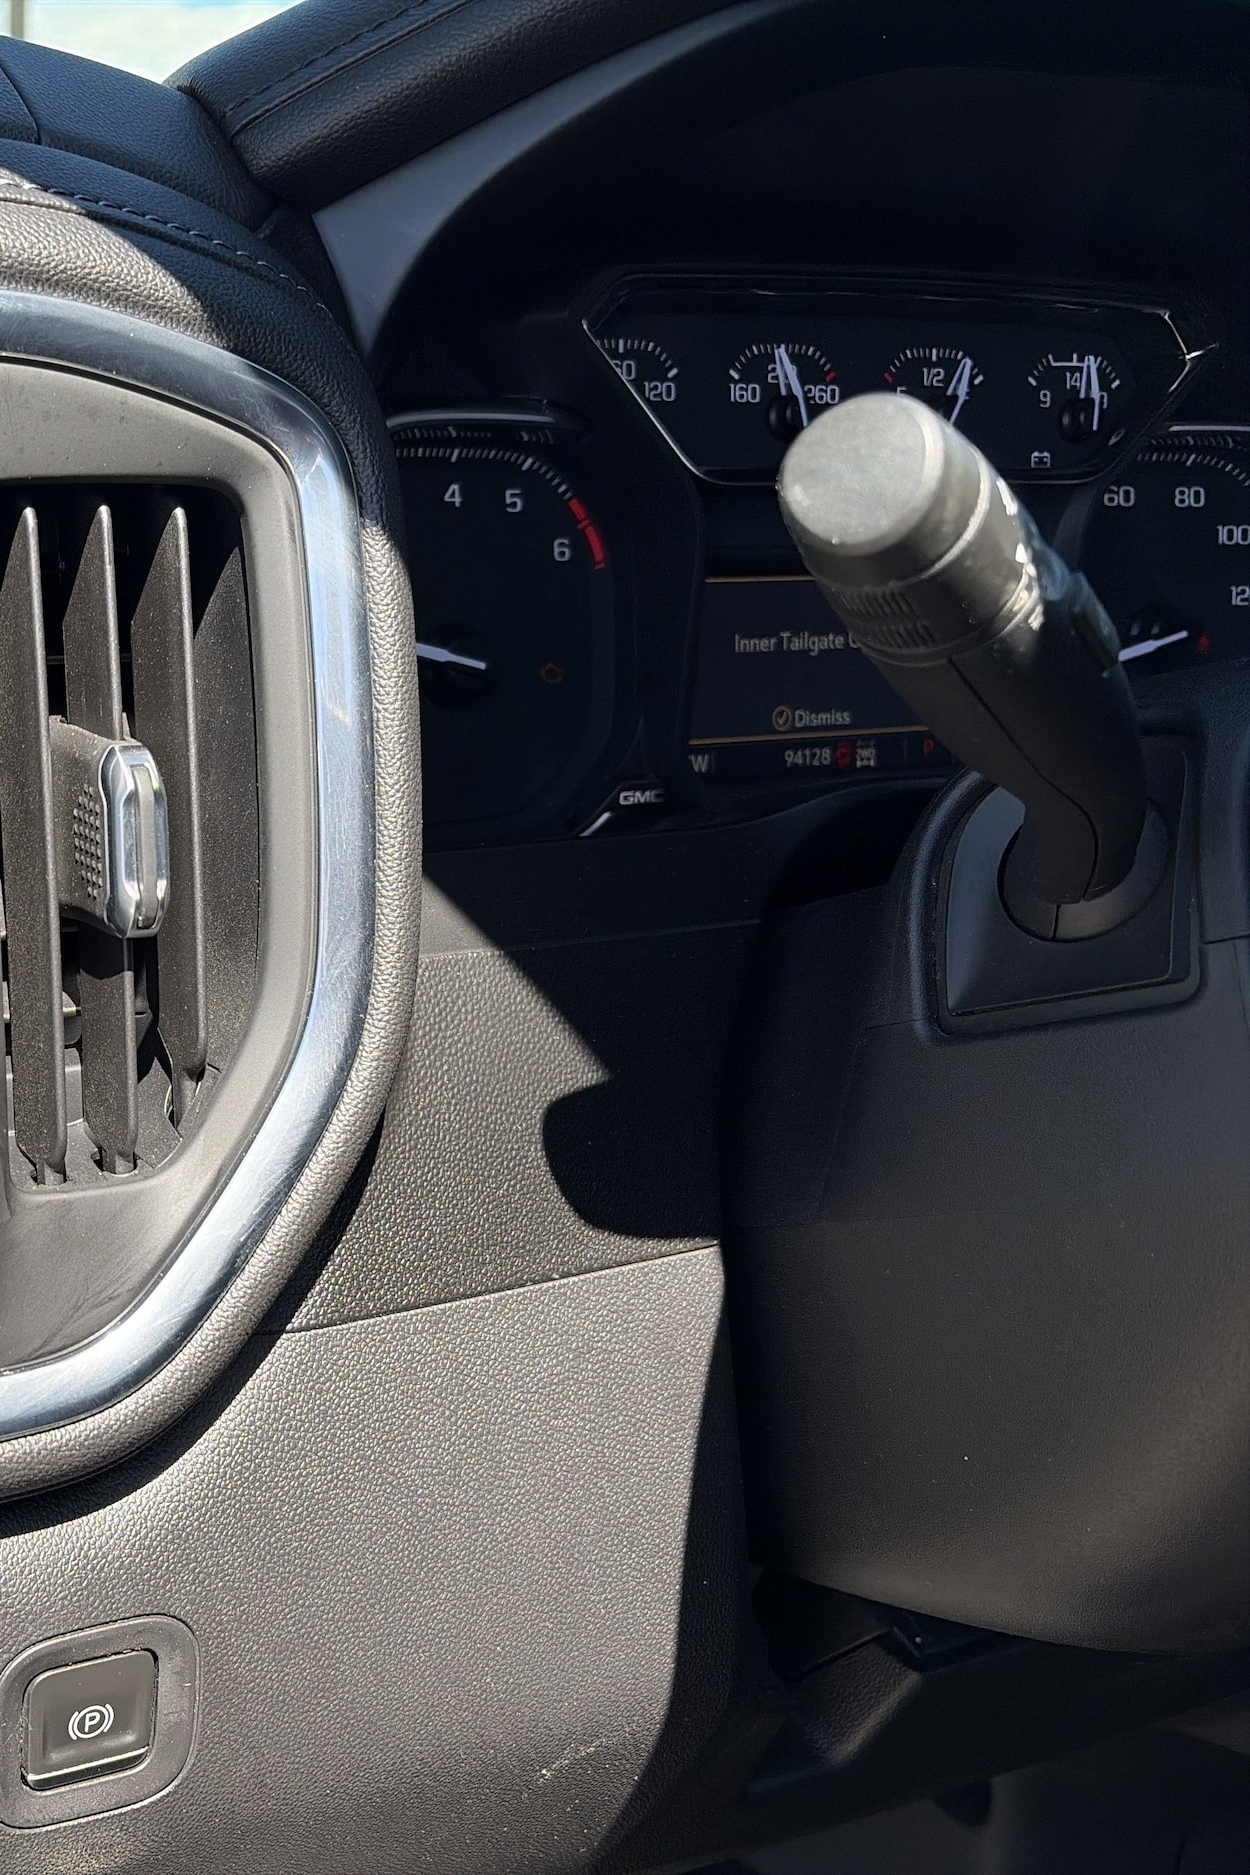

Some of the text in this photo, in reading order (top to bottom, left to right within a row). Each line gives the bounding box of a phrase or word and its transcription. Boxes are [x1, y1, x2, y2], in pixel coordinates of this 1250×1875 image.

[643, 381, 677, 402] 120
[729, 383, 761, 403] 160
[1039, 389, 1051, 408] 9
[443, 483, 462, 507] 4
[504, 489, 523, 512] 5
[1103, 485, 1136, 507] 60
[1173, 485, 1206, 508] 80
[553, 538, 571, 561] 6
[734, 632, 778, 653] Inner
[779, 630, 844, 656] Tailgate
[794, 708, 851, 728] Dismiss
[689, 754, 710, 774] W
[784, 747, 831, 767] 94128
[618, 788, 665, 806] GMC
[84, 1711, 101, 1733] P
